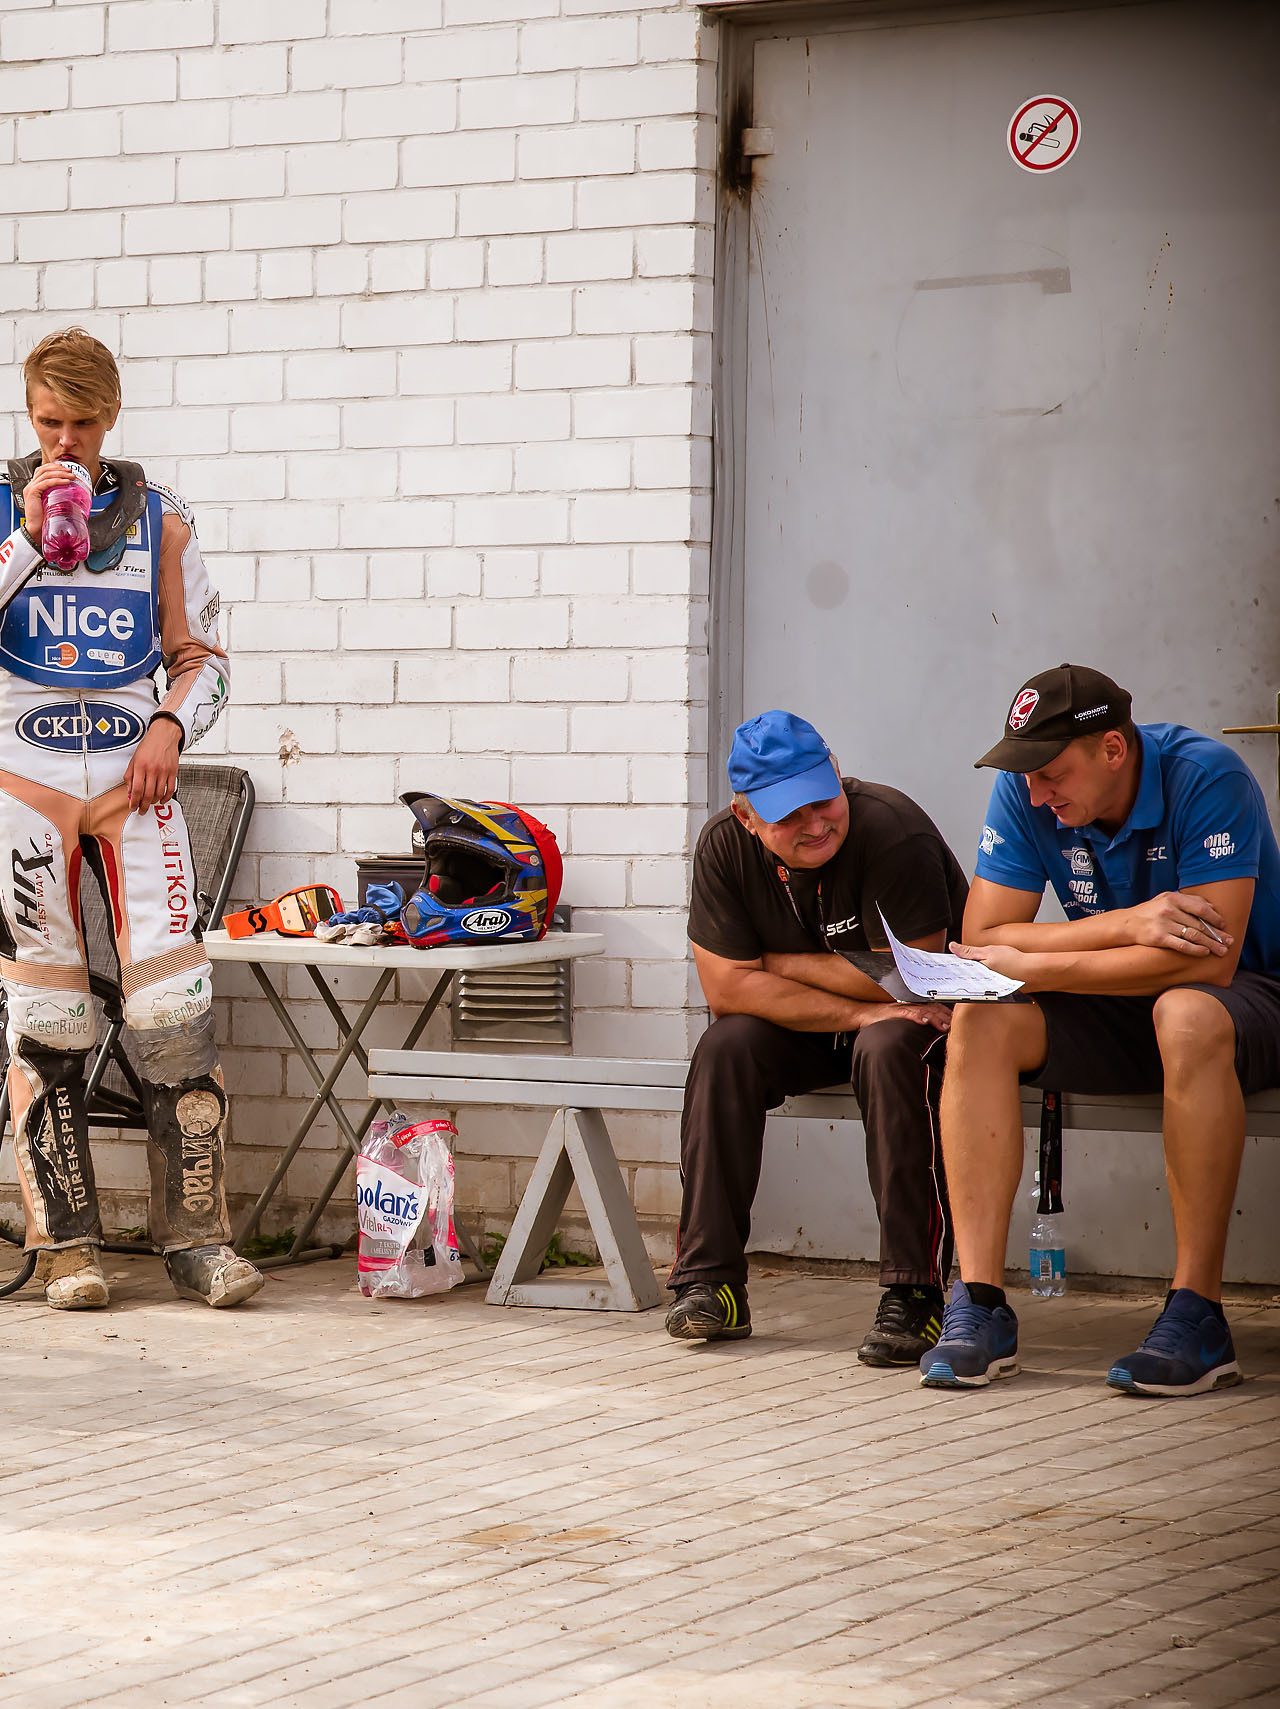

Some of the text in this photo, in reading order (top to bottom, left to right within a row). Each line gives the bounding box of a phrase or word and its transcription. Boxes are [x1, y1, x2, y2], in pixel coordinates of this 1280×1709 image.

[123, 564, 147, 574] Tire
[28, 594, 135, 641] Nice
[44, 832, 53, 850] TO
[1204, 832, 1231, 849] one
[1076, 853, 1090, 865] FIM
[1209, 842, 1235, 859] sport
[35, 872, 45, 898] WAY
[1069, 880, 1094, 894] one
[467, 913, 506, 929] Arai
[826, 915, 860, 937] SEC
[55, 1087, 89, 1212] TUREKSPERT
